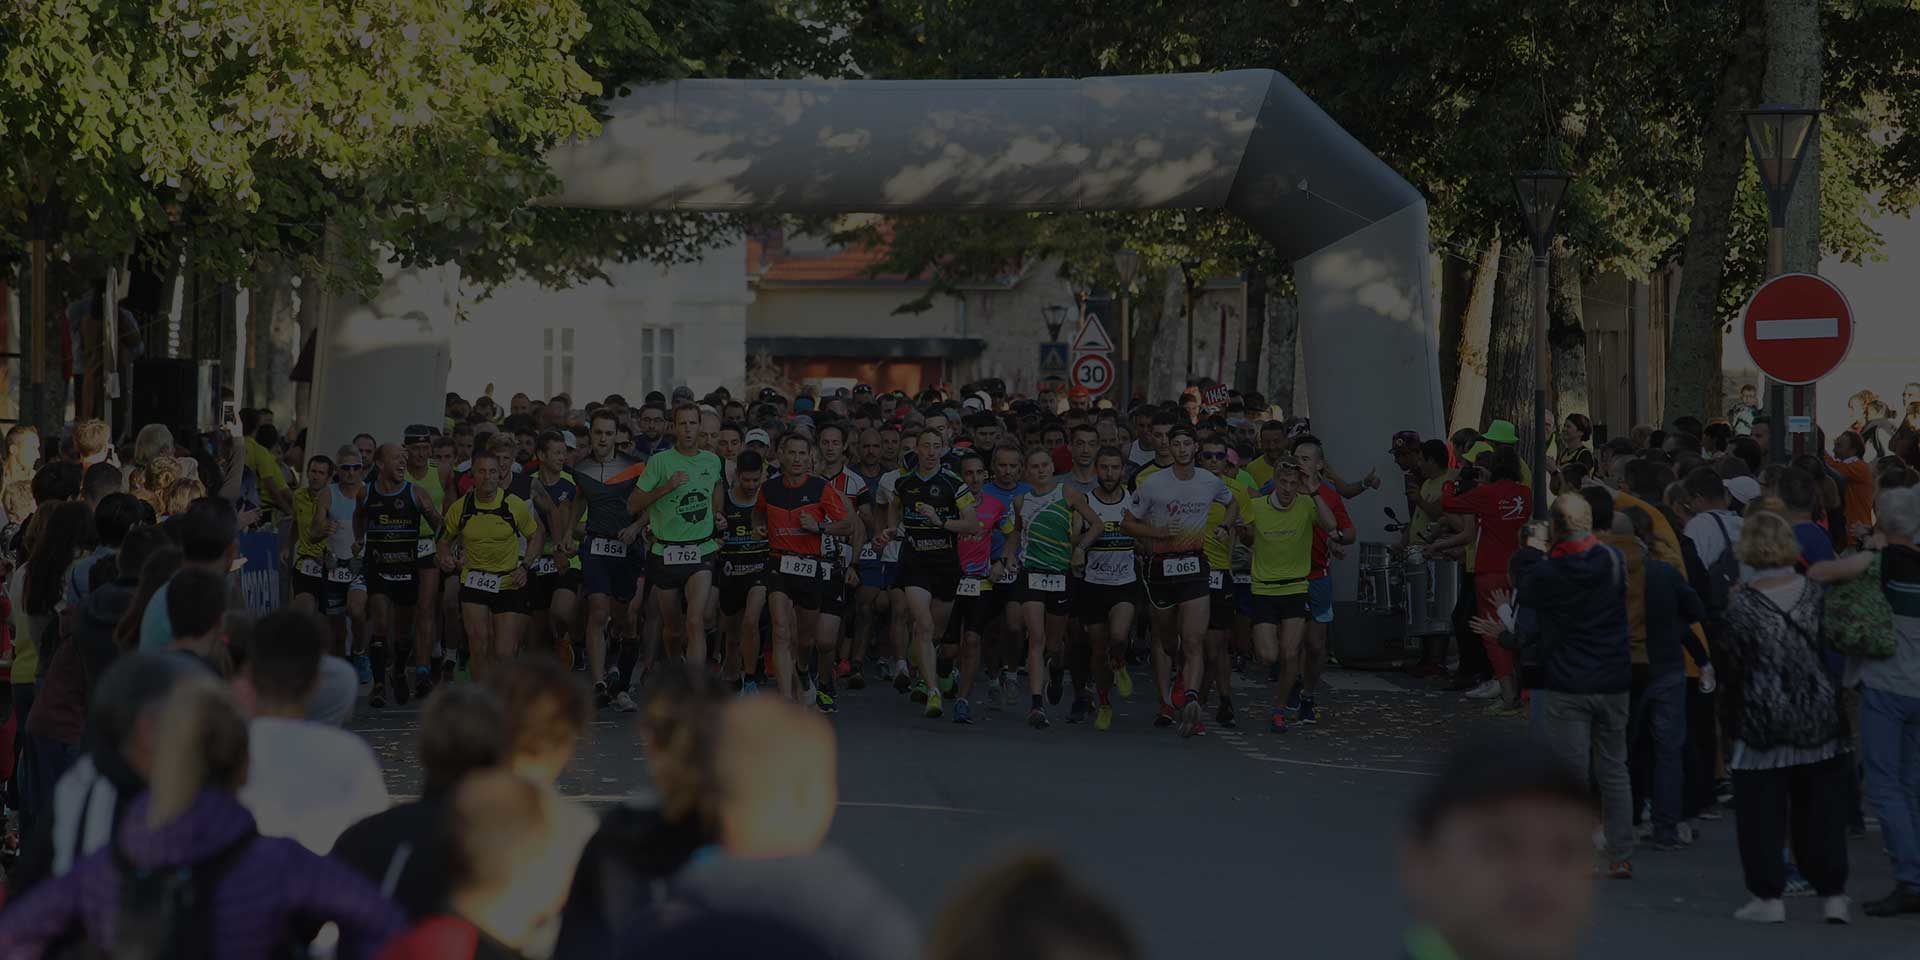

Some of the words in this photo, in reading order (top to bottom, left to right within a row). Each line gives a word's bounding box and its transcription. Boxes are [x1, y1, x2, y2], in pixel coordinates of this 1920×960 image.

[1081, 366, 1104, 382] 30
[1206, 387, 1227, 404] 1H45
[596, 543, 600, 551] 1
[604, 544, 623, 554] 854
[668, 552, 673, 560] 1
[678, 551, 697, 560] 762
[793, 562, 813, 573] 878
[1167, 564, 1174, 573] 2
[1177, 562, 1196, 572] 065
[338, 570, 351, 580] 85
[468, 575, 474, 584] 1
[477, 578, 497, 589] 842
